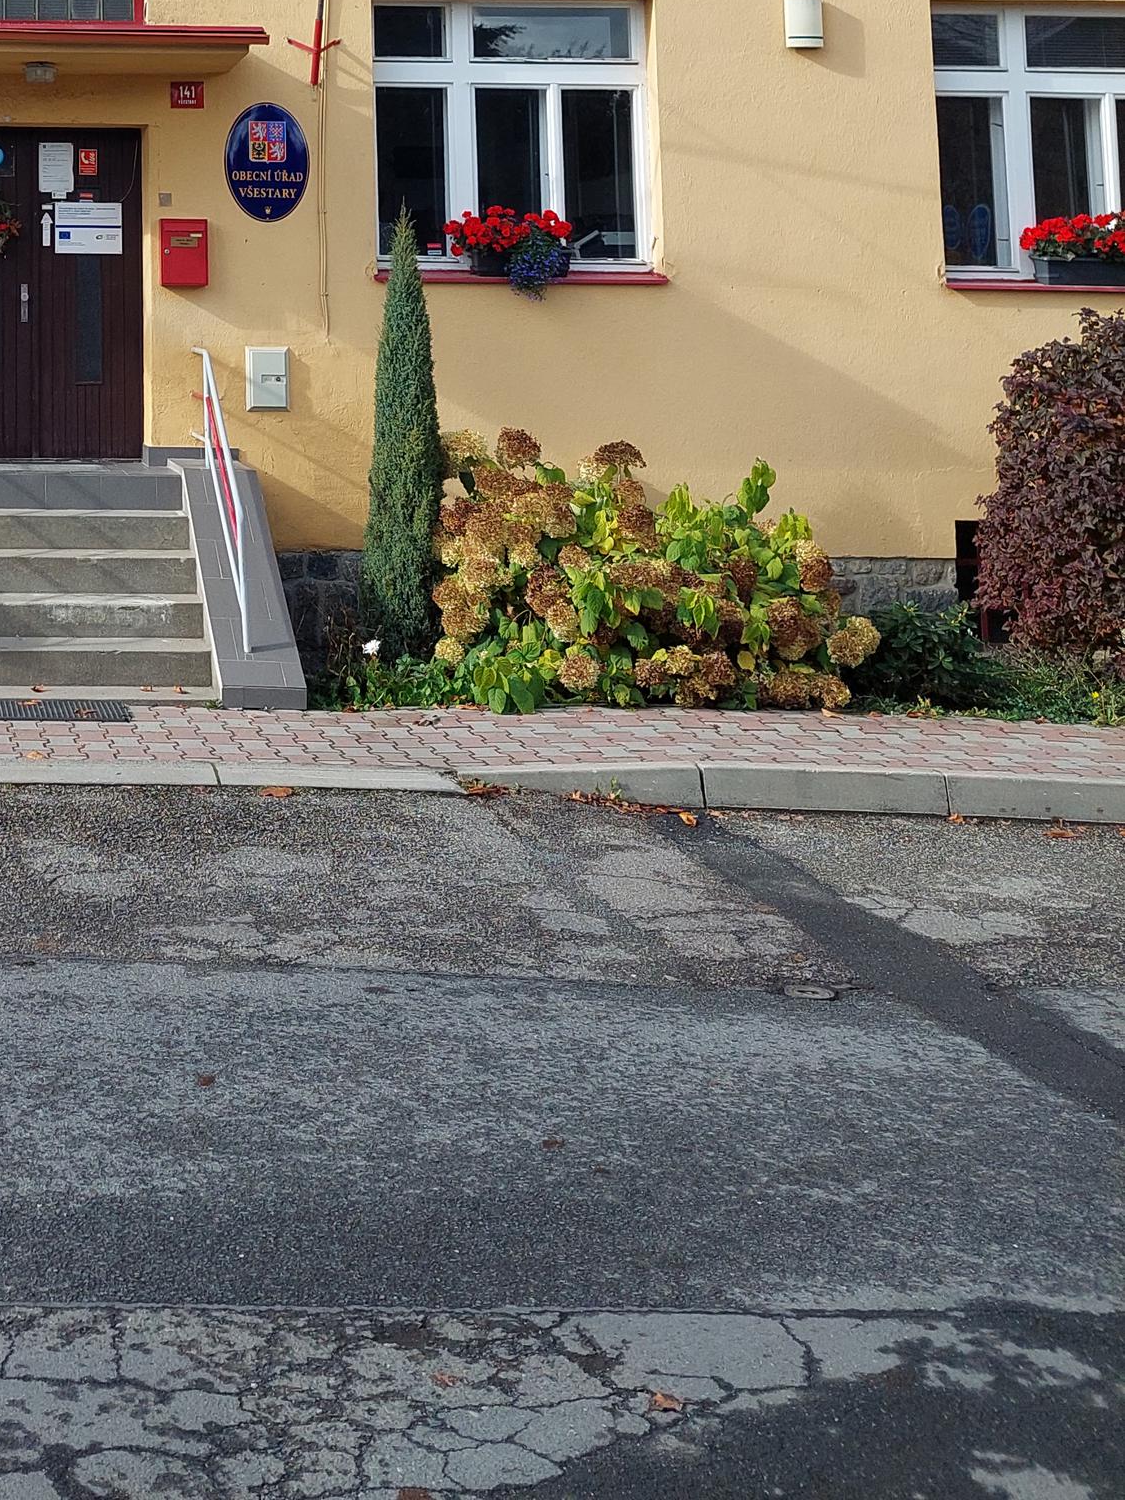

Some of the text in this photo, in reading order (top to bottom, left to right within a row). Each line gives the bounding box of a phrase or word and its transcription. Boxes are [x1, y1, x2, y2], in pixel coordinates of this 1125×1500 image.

[179, 85, 195, 98] 141
[232, 169, 304, 182] OBECNÍ ÚŘAD
[238, 185, 297, 199] VŠESTARY
